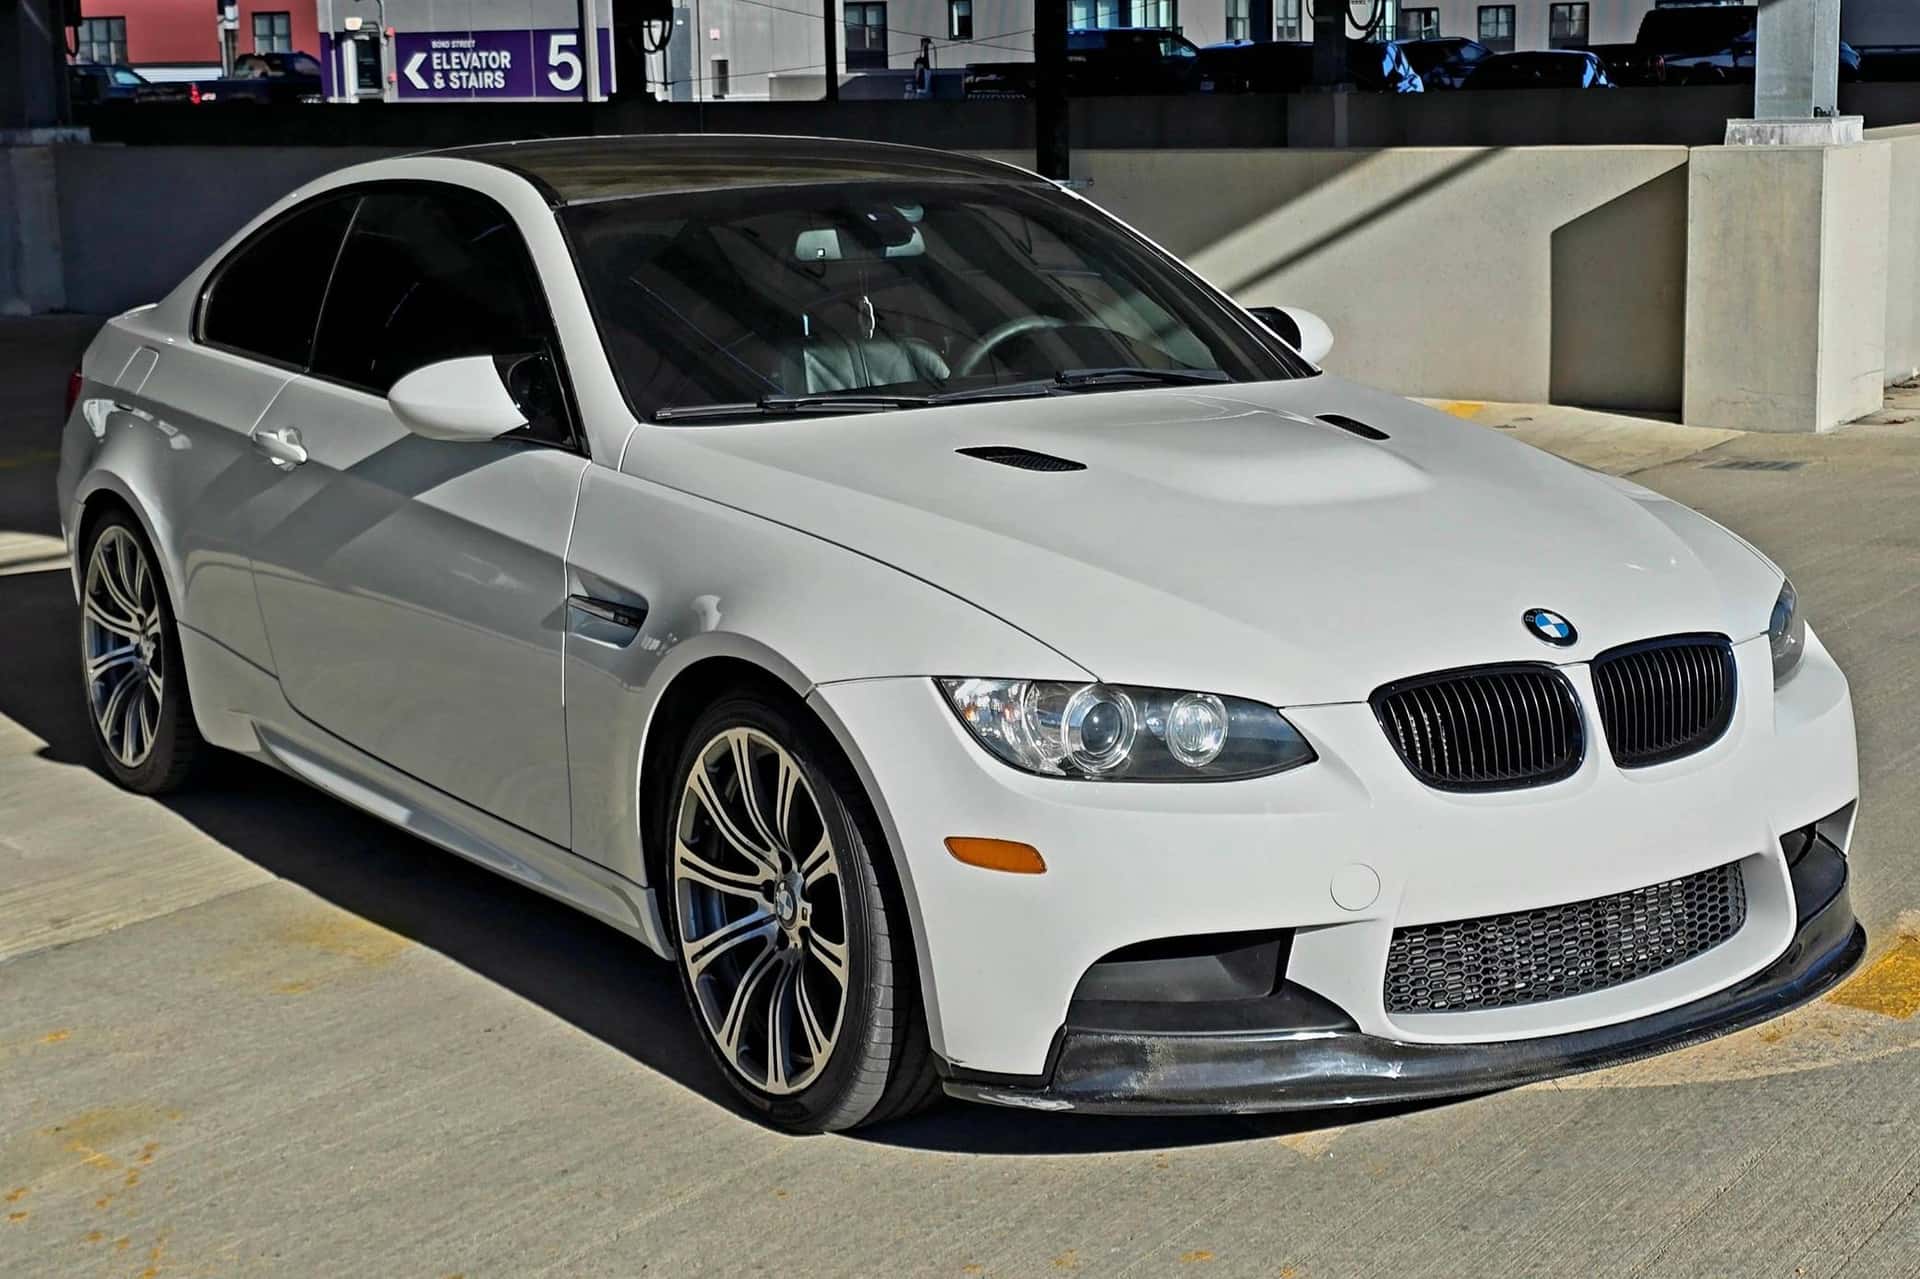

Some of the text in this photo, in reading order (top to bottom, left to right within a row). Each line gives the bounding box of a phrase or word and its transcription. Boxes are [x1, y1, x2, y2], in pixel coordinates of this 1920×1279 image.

[431, 39, 475, 48] BOND STREET
[432, 51, 511, 70] ELEVATOR
[547, 34, 582, 91] 5
[433, 71, 505, 89] & STAIRS
